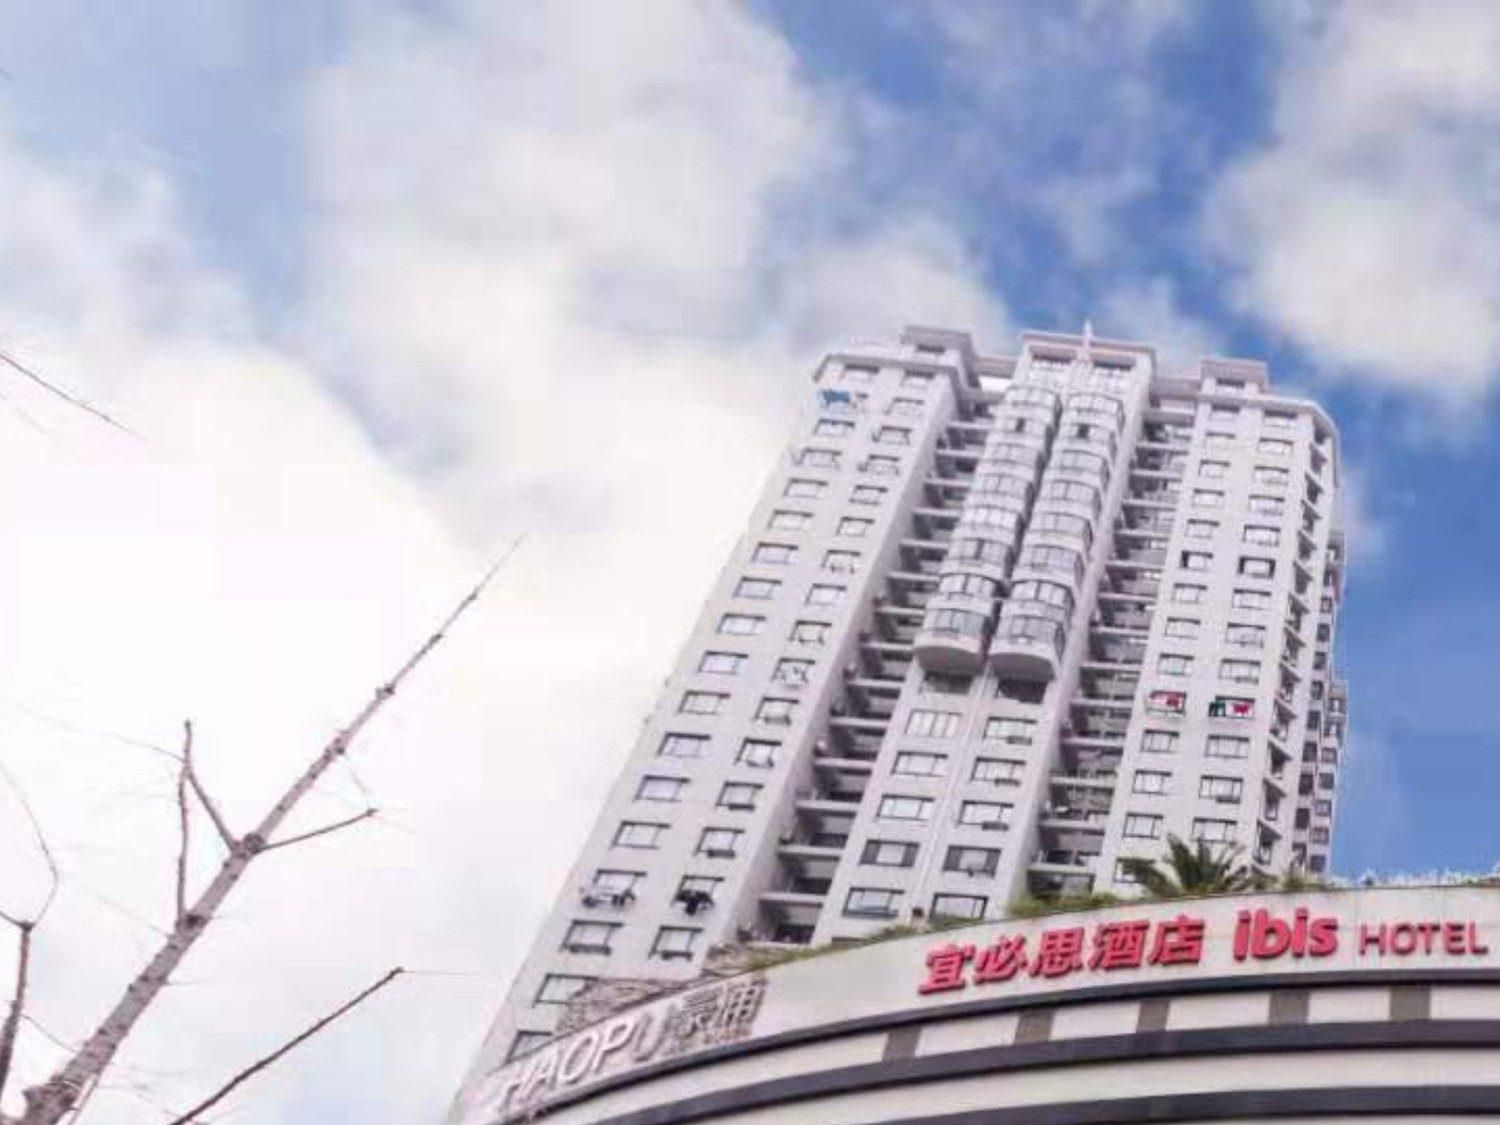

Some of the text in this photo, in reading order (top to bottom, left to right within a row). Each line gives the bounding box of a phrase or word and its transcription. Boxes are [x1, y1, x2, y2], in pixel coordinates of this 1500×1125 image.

[918, 908, 1489, 995] 宜必思酒店 ibis HOTEL
